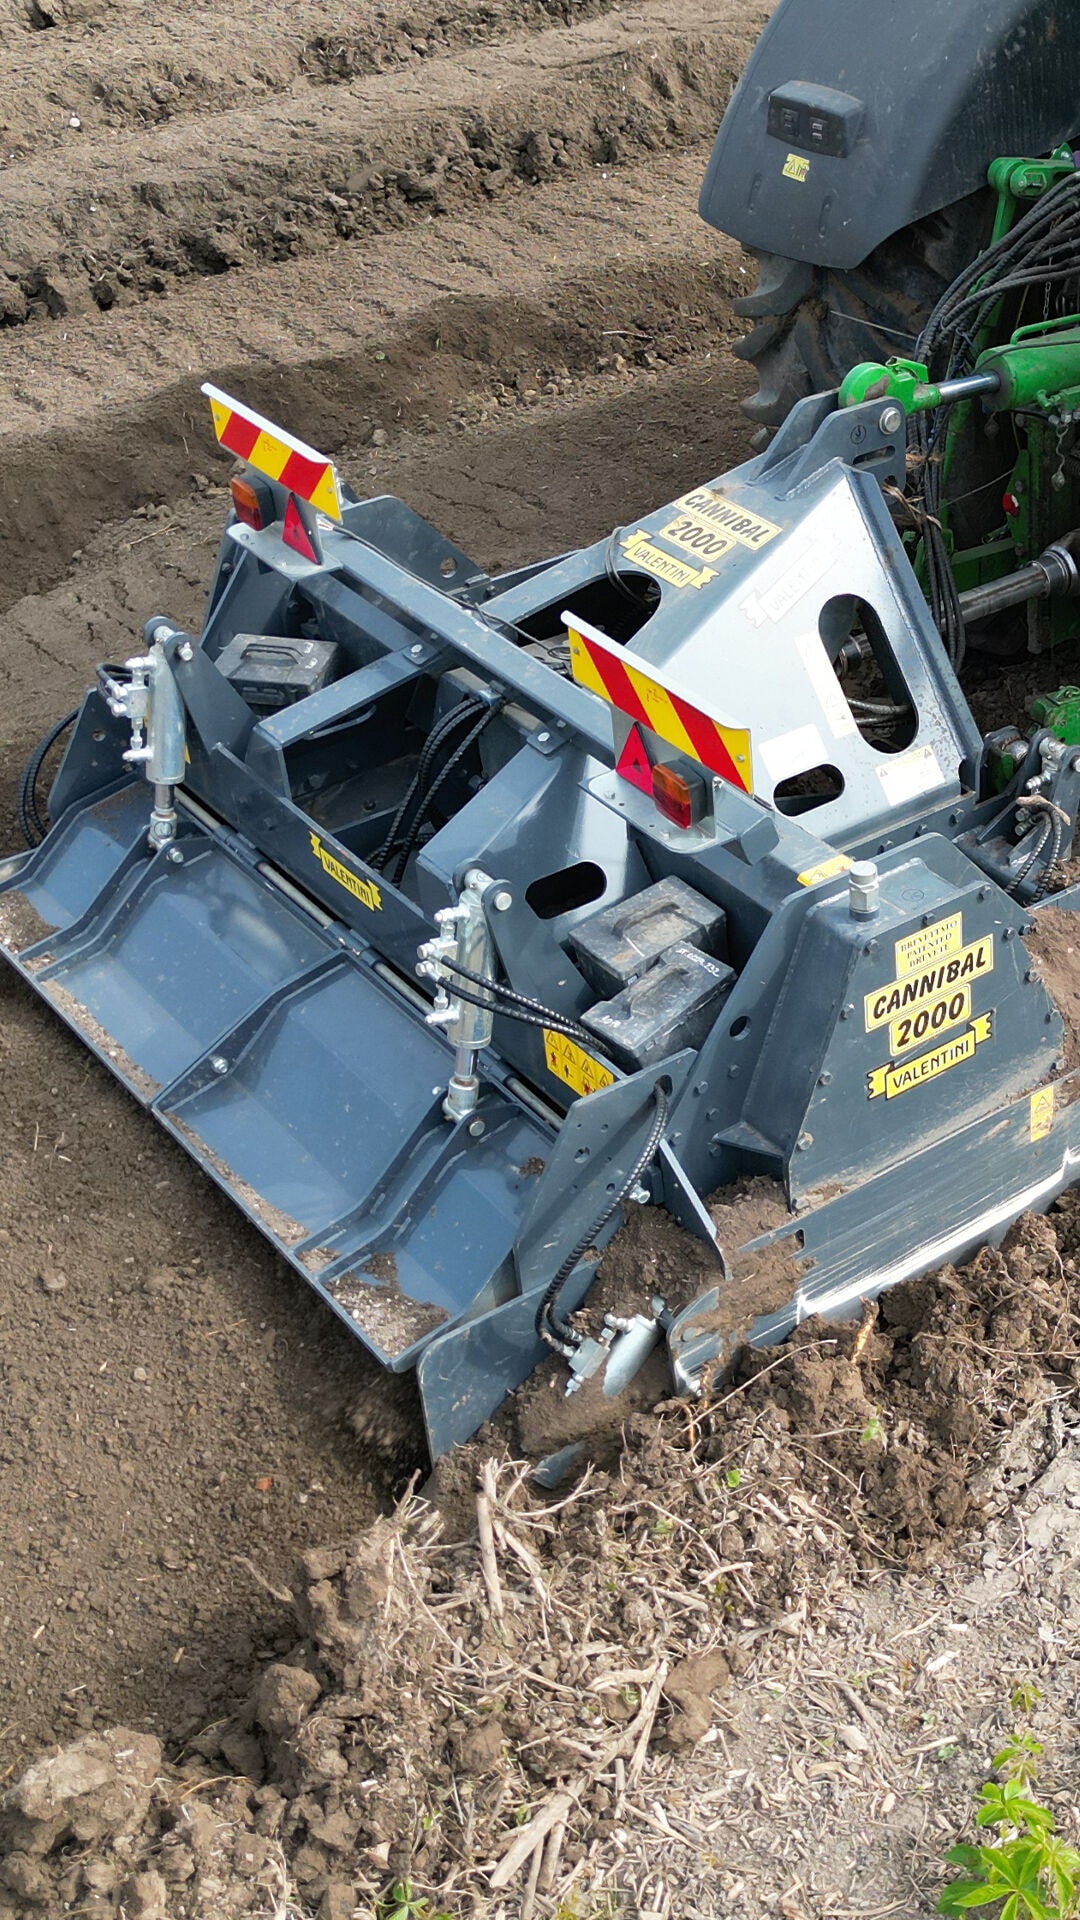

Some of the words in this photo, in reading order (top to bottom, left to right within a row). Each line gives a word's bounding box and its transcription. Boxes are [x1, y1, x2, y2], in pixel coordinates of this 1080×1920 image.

[668, 520, 728, 555] 2000
[684, 494, 770, 542] CANNIBAL
[633, 547, 691, 583] VALENTINI
[325, 857, 371, 903] VALENTINI
[873, 947, 986, 1019] CANNIBAL
[897, 992, 964, 1047] 2000
[893, 1040, 969, 1088] VALENTINI
